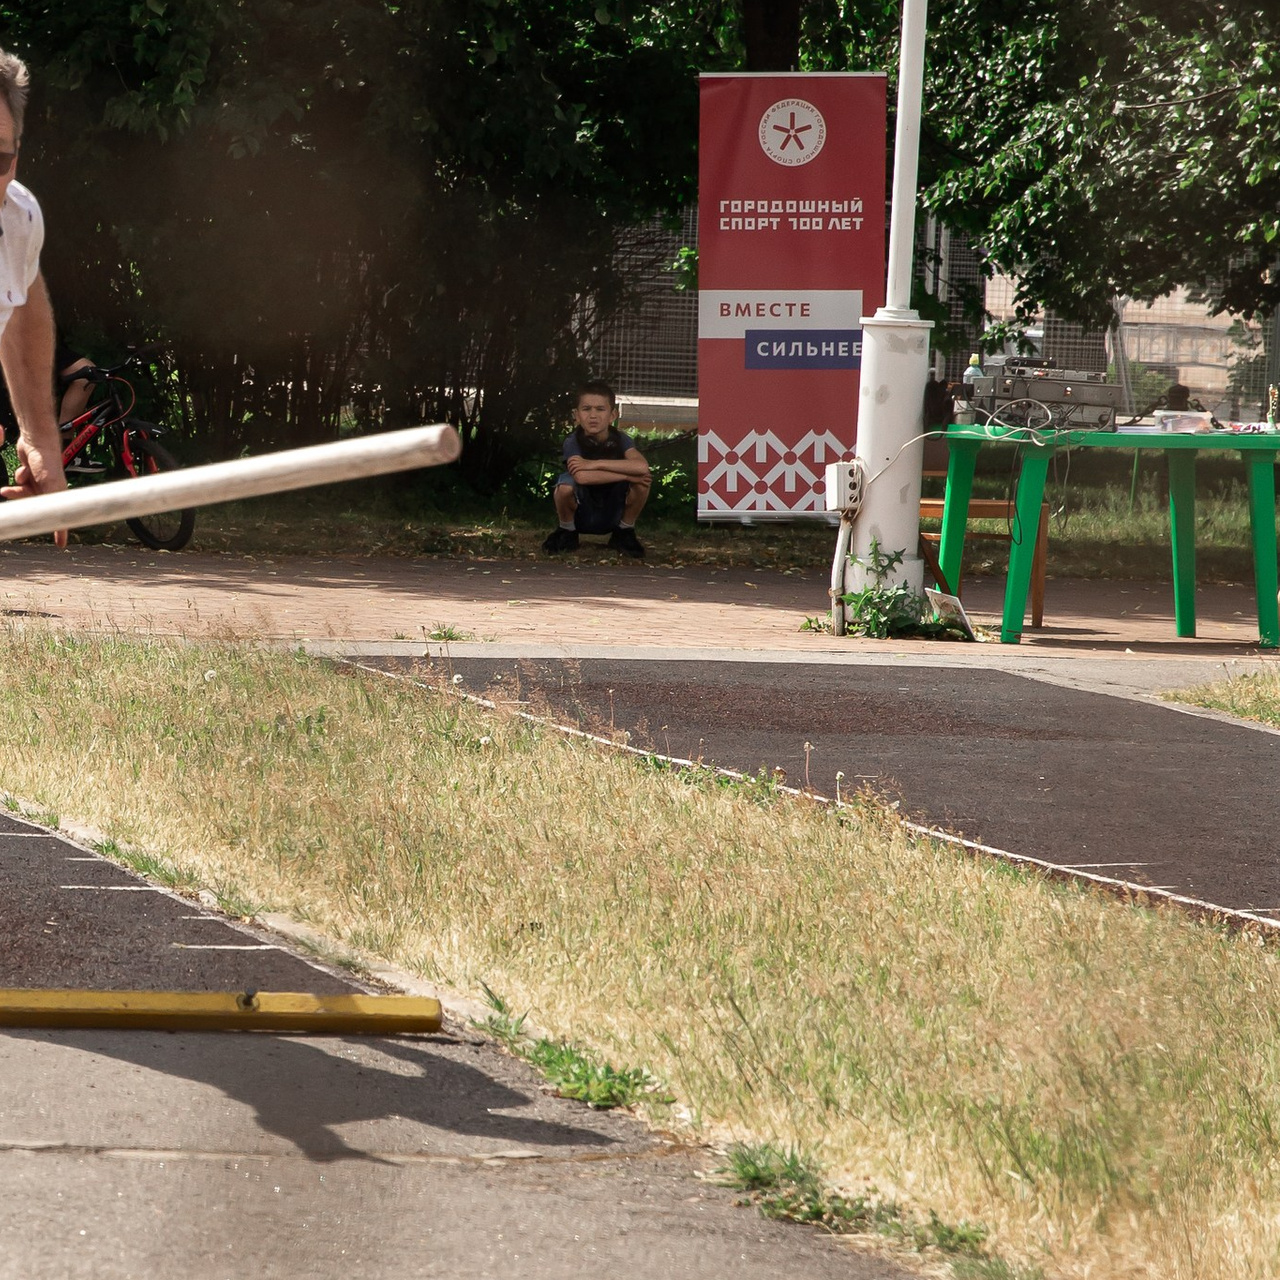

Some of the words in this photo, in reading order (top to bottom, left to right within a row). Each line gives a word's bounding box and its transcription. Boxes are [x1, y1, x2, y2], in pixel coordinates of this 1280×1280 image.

[771, 101, 815, 113] ФЕДЕРАЦИЯ
[760, 113, 771, 145] РОССИИ
[795, 113, 825, 164] ГОРОДОШНОГО
[766, 146, 793, 164] СПОРТА
[719, 197, 864, 213] ГОРОДОШНЫЙ
[719, 217, 781, 231] СПОРТ
[788, 217, 823, 231] 100
[827, 217, 864, 231] ЛЕТ
[719, 302, 811, 318] ВМЕСТЕ
[756, 341, 863, 358] СИЛЬНЕЕ
